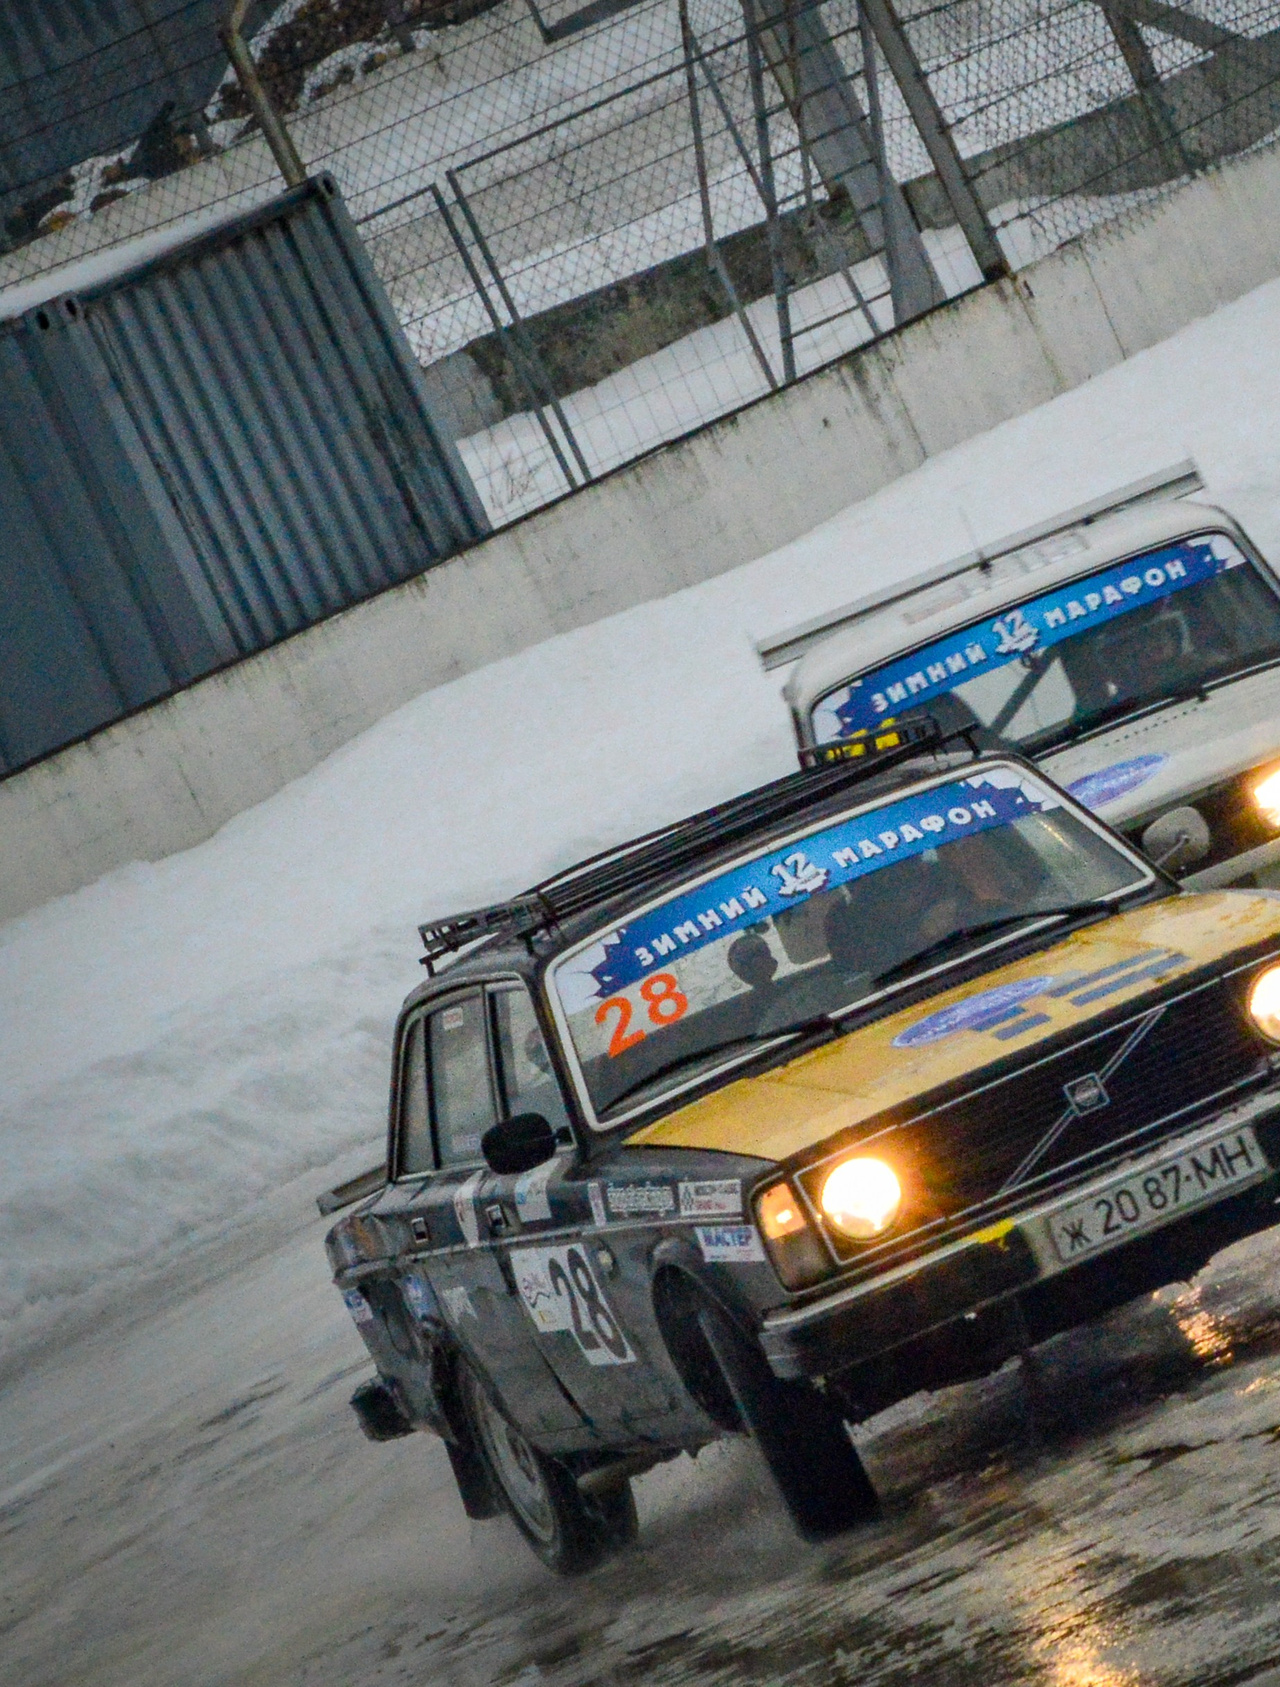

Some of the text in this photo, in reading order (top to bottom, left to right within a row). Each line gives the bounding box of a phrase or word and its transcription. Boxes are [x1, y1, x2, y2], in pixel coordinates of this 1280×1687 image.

[871, 558, 1188, 712] ЗИМНИЙ 12 МАРАФОН
[634, 799, 997, 968] ЗИМНИЙ 12 МАРАФОН
[594, 972, 690, 1059] 28
[1062, 1218, 1091, 1251] Ж
[548, 1247, 628, 1360] 28
